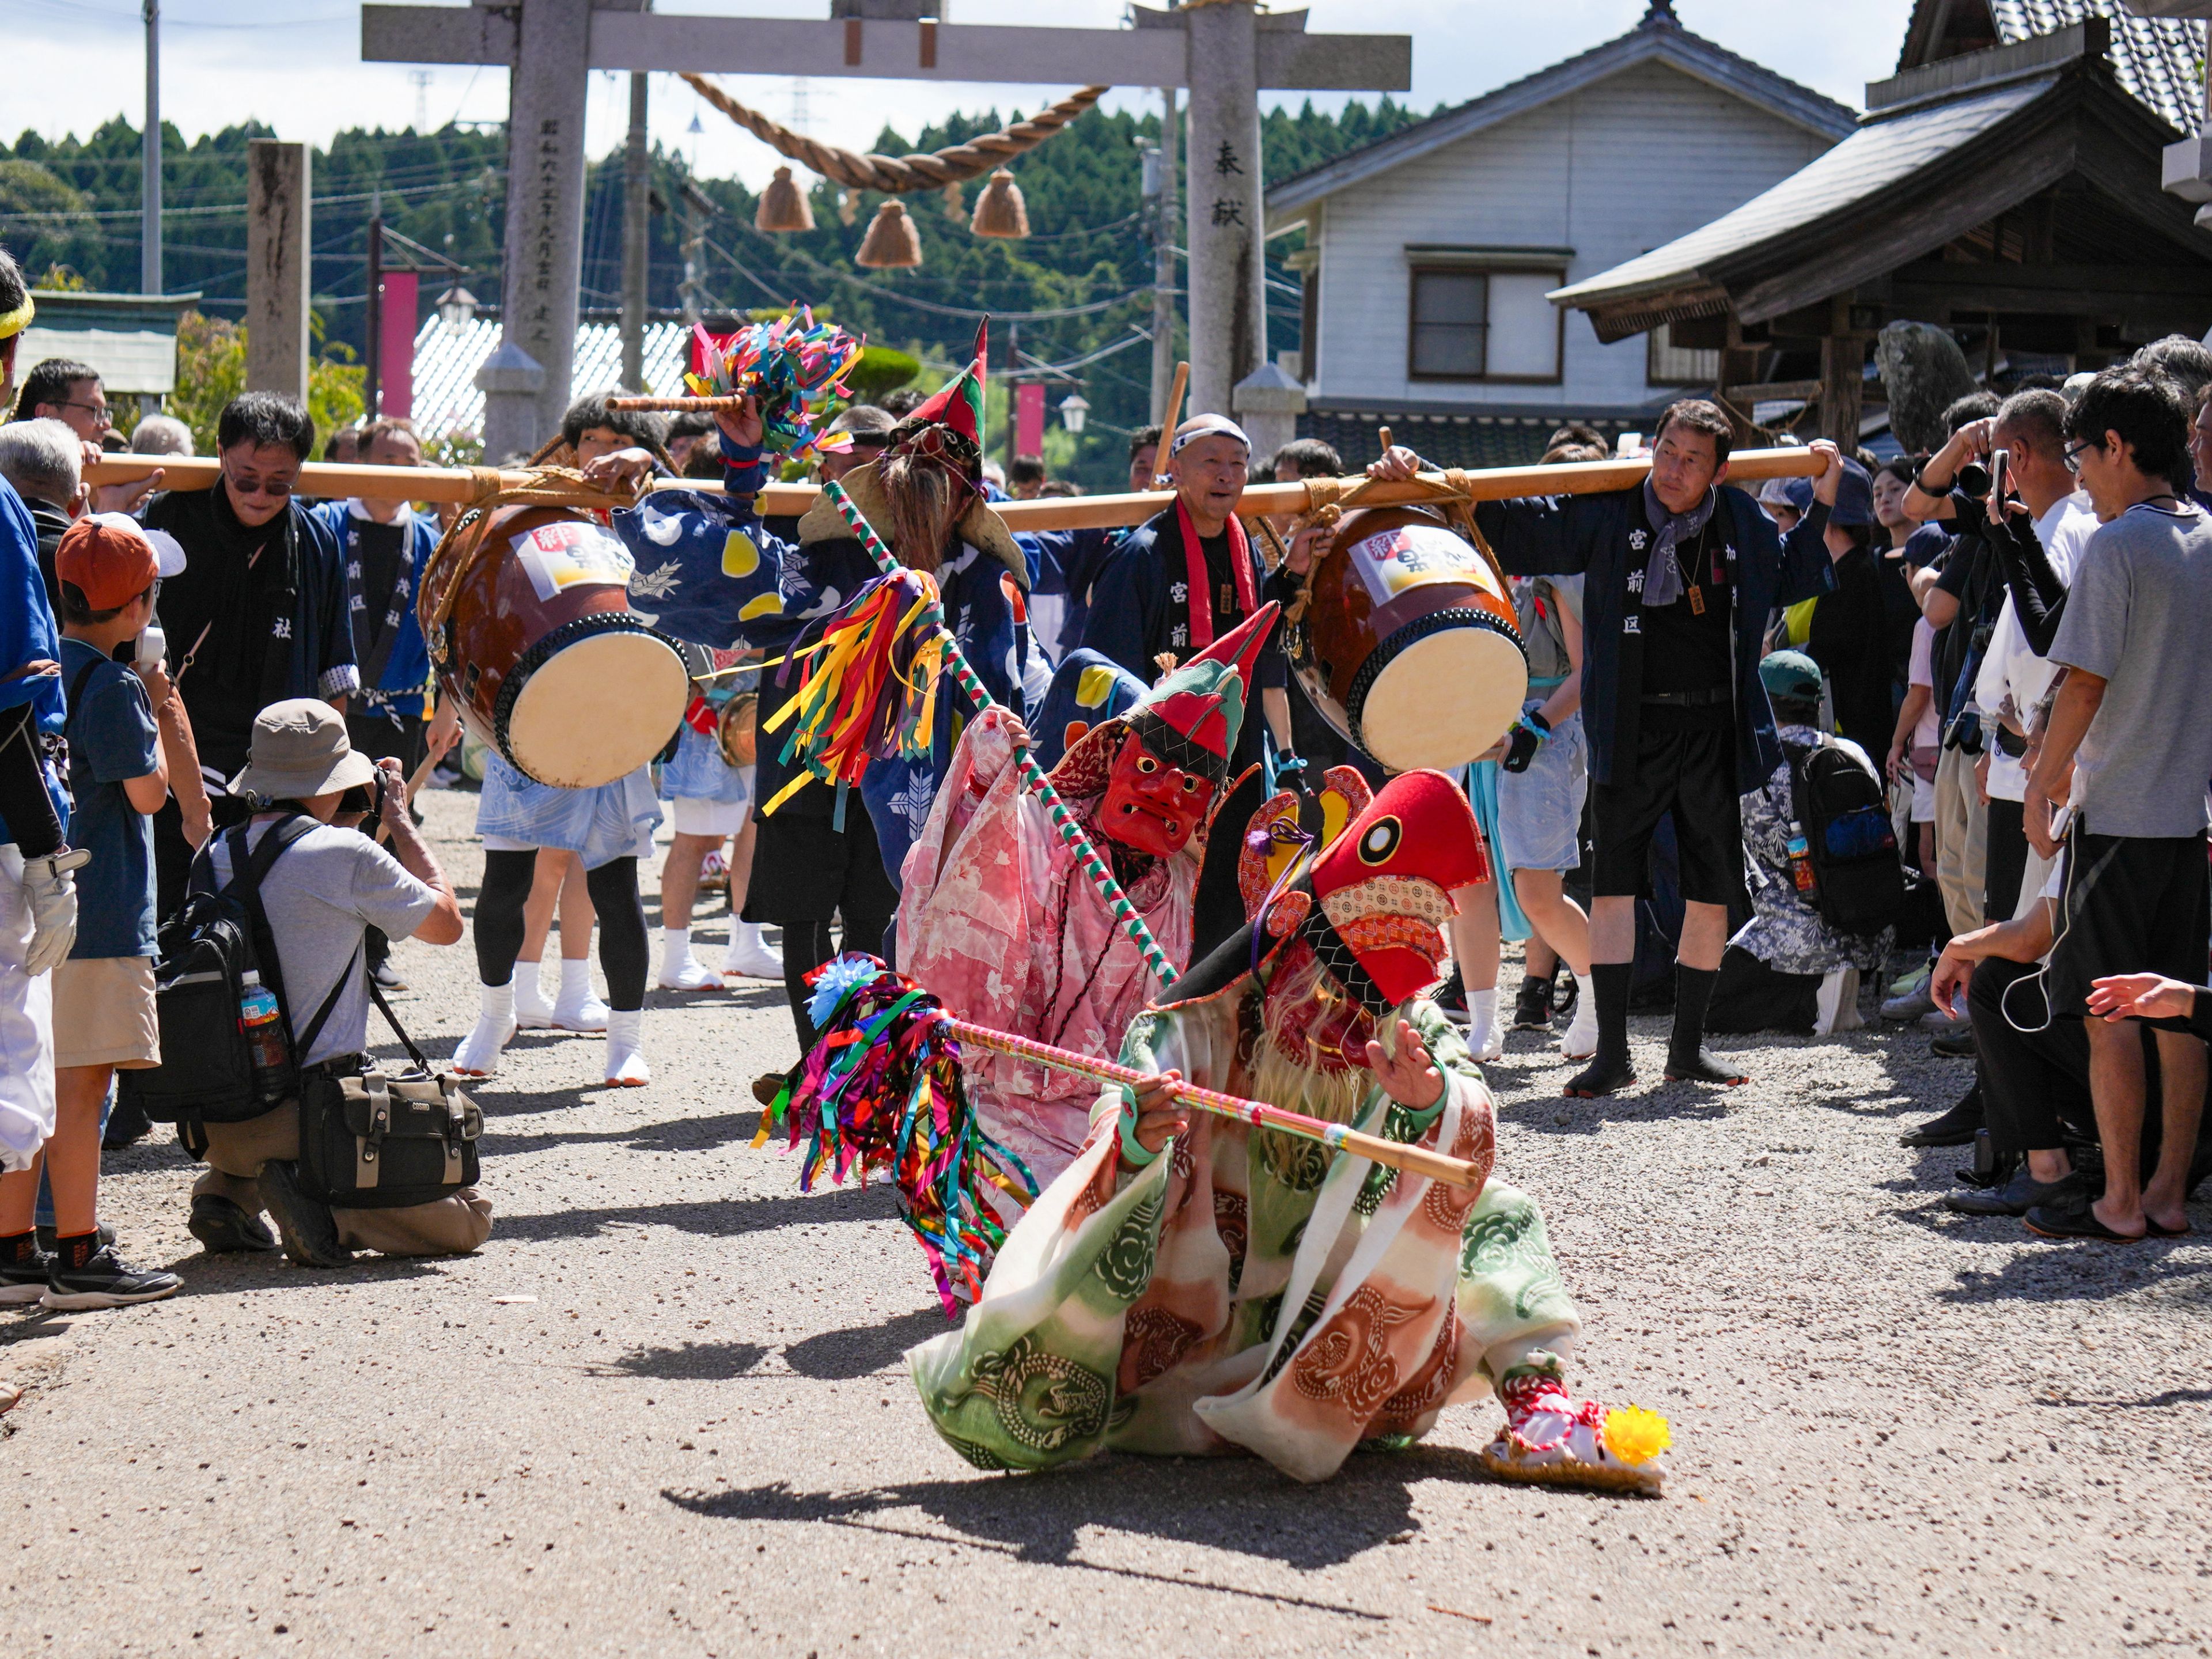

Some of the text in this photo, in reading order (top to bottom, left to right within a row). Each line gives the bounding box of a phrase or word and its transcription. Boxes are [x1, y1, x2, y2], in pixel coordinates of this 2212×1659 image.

[1212, 139, 1244, 226] 奉献
[347, 529, 367, 612] 宮前区
[1623, 529, 1647, 634] 宮前区
[1170, 581, 1188, 647] 宮前
